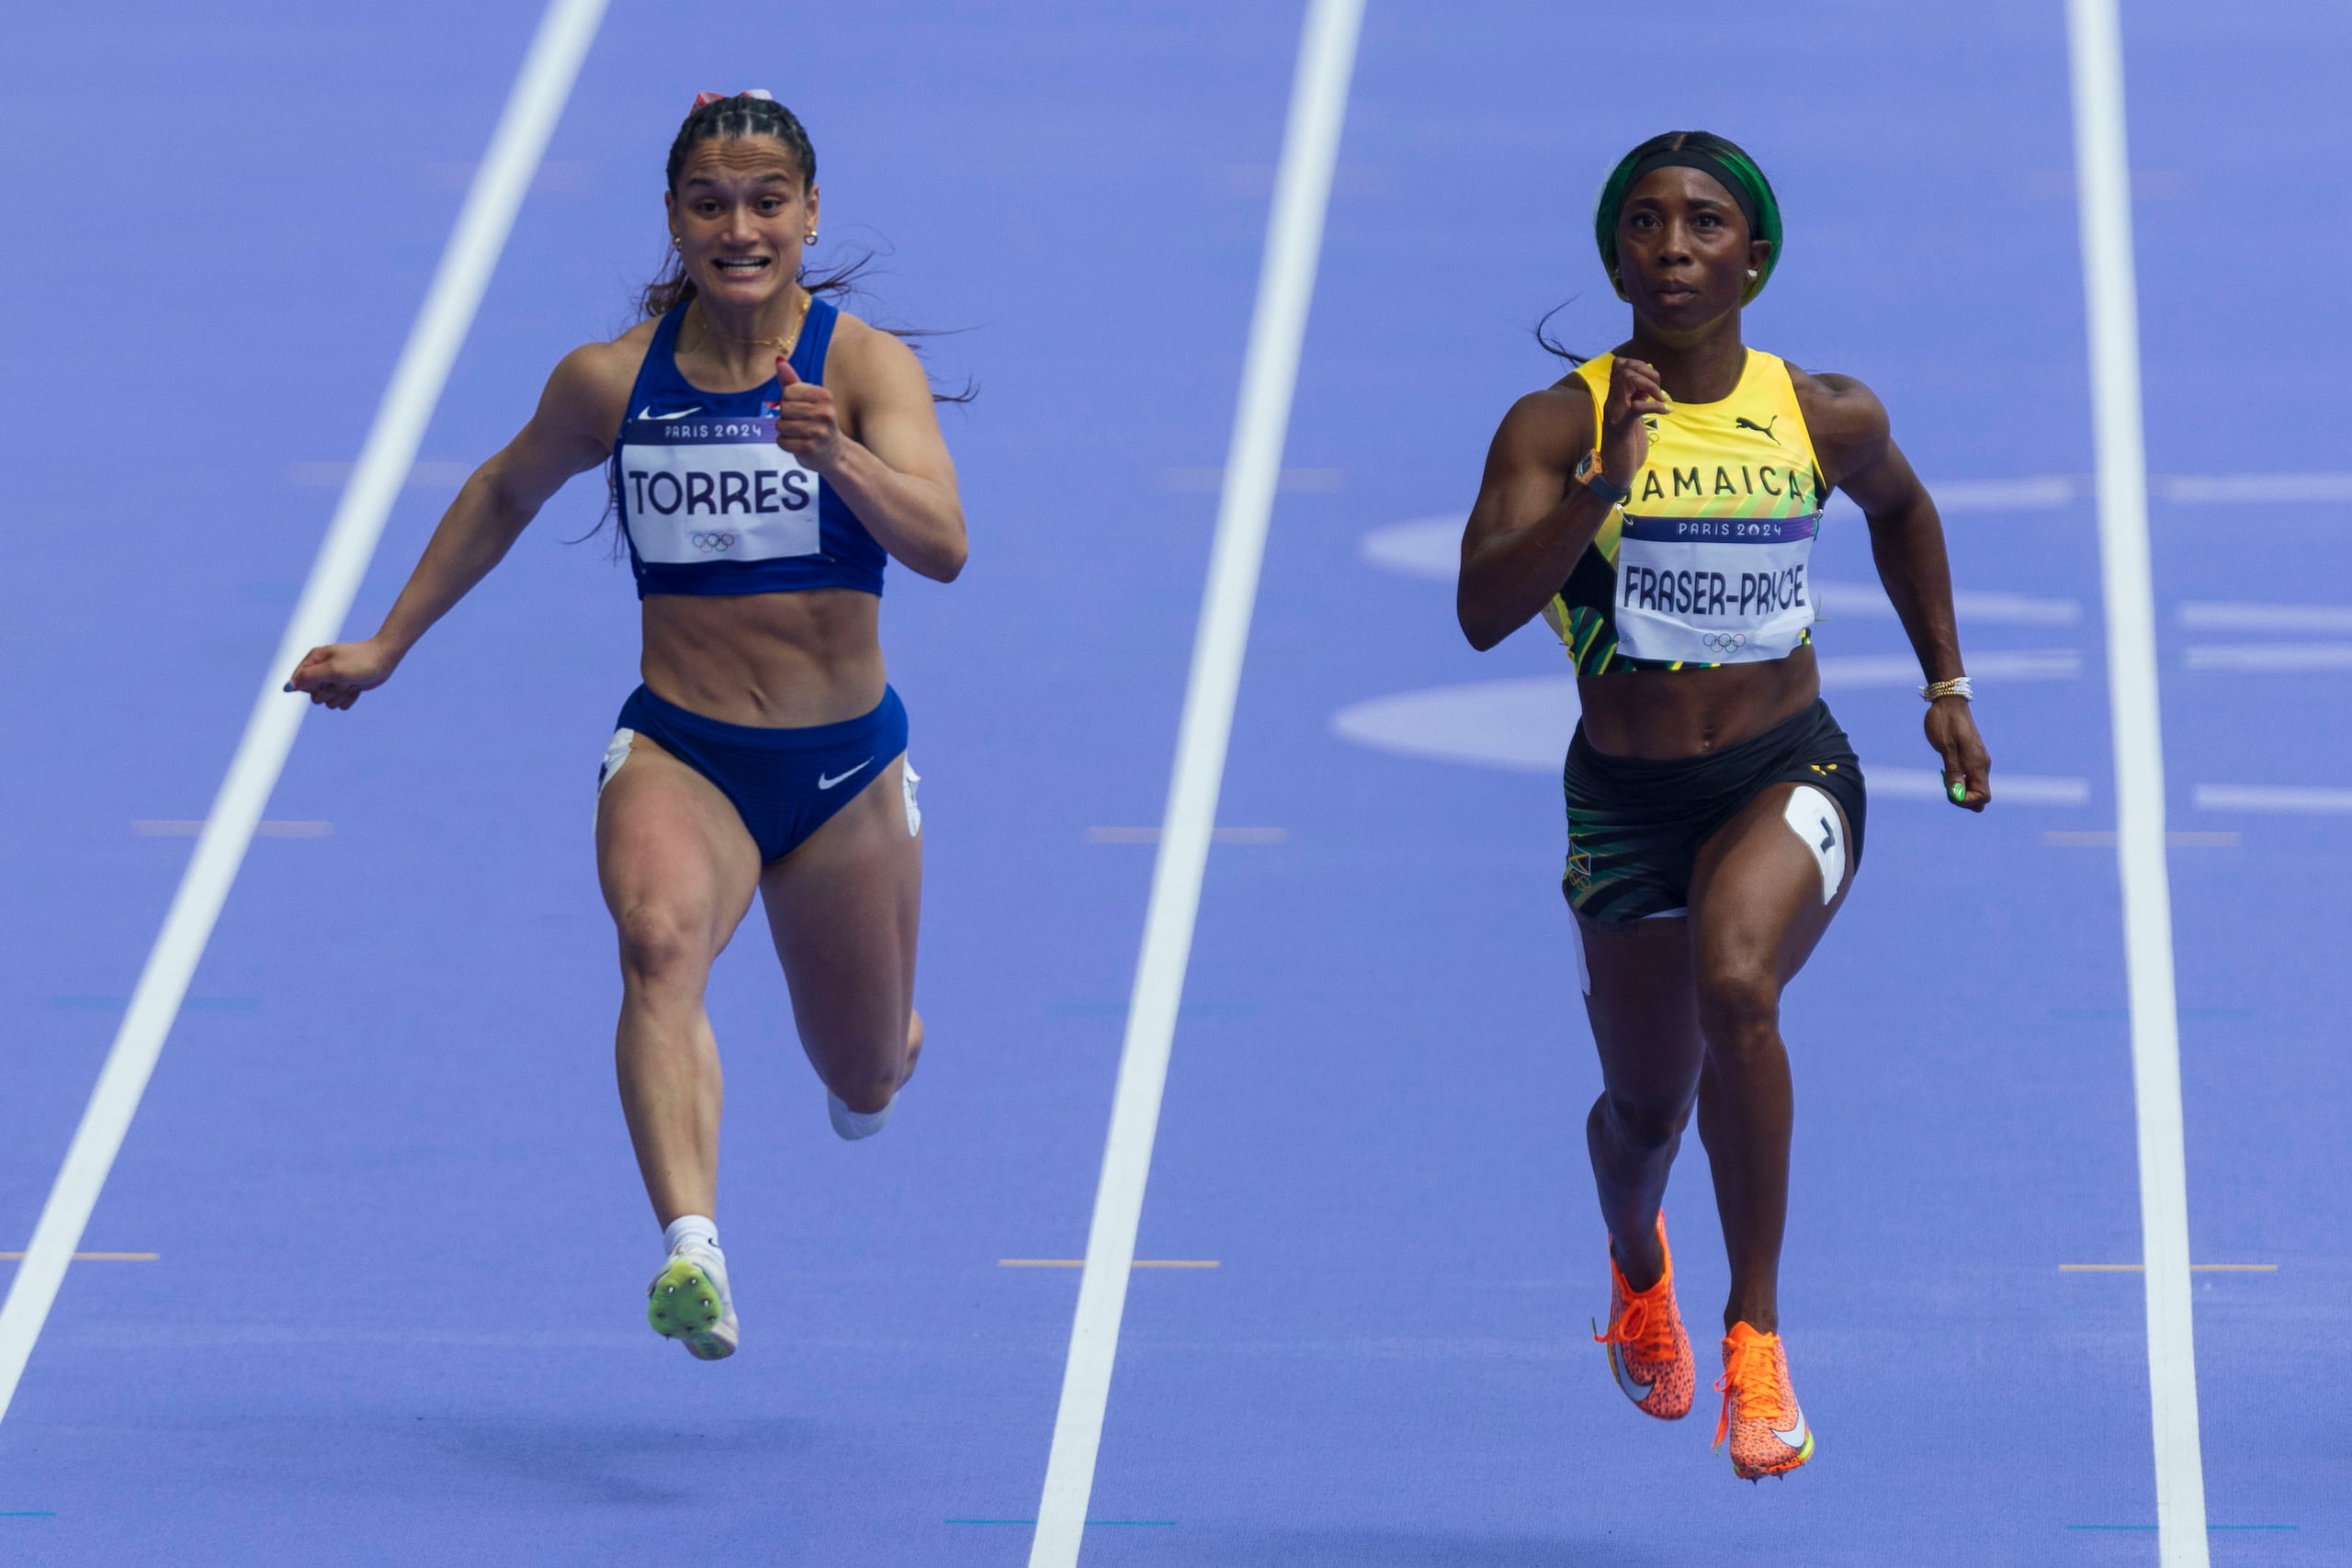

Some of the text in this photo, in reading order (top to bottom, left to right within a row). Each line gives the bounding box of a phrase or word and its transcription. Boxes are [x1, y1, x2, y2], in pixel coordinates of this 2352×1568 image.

[665, 423, 762, 438] PARIS 2024
[628, 469, 810, 515] TORRES
[1679, 523, 1781, 536] PARIS 2024
[1623, 564, 1807, 616] FRASER-PRYCE
